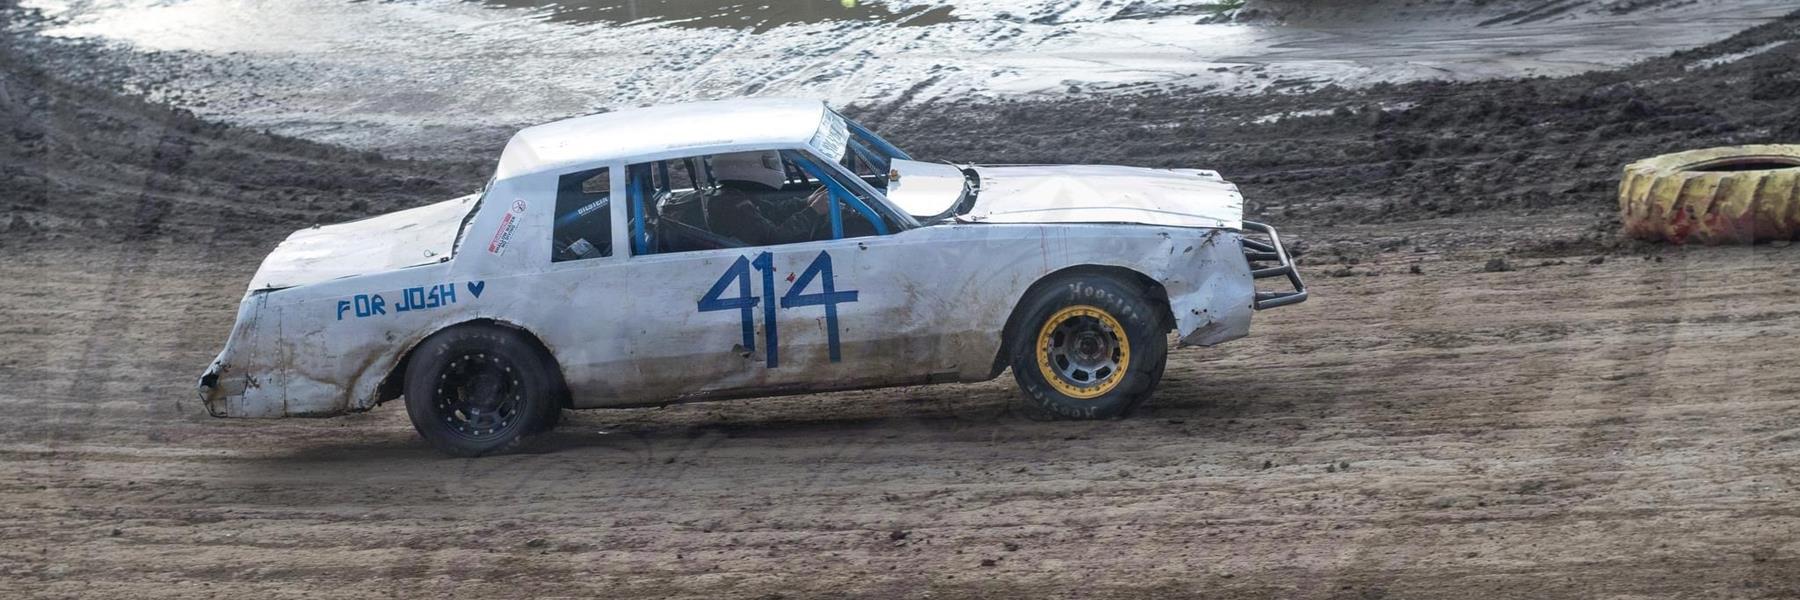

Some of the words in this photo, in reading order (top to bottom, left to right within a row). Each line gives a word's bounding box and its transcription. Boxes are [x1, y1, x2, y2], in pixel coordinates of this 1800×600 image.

[337, 294, 386, 320] FOR
[395, 283, 456, 312] JOSH
[697, 250, 859, 368] 414
